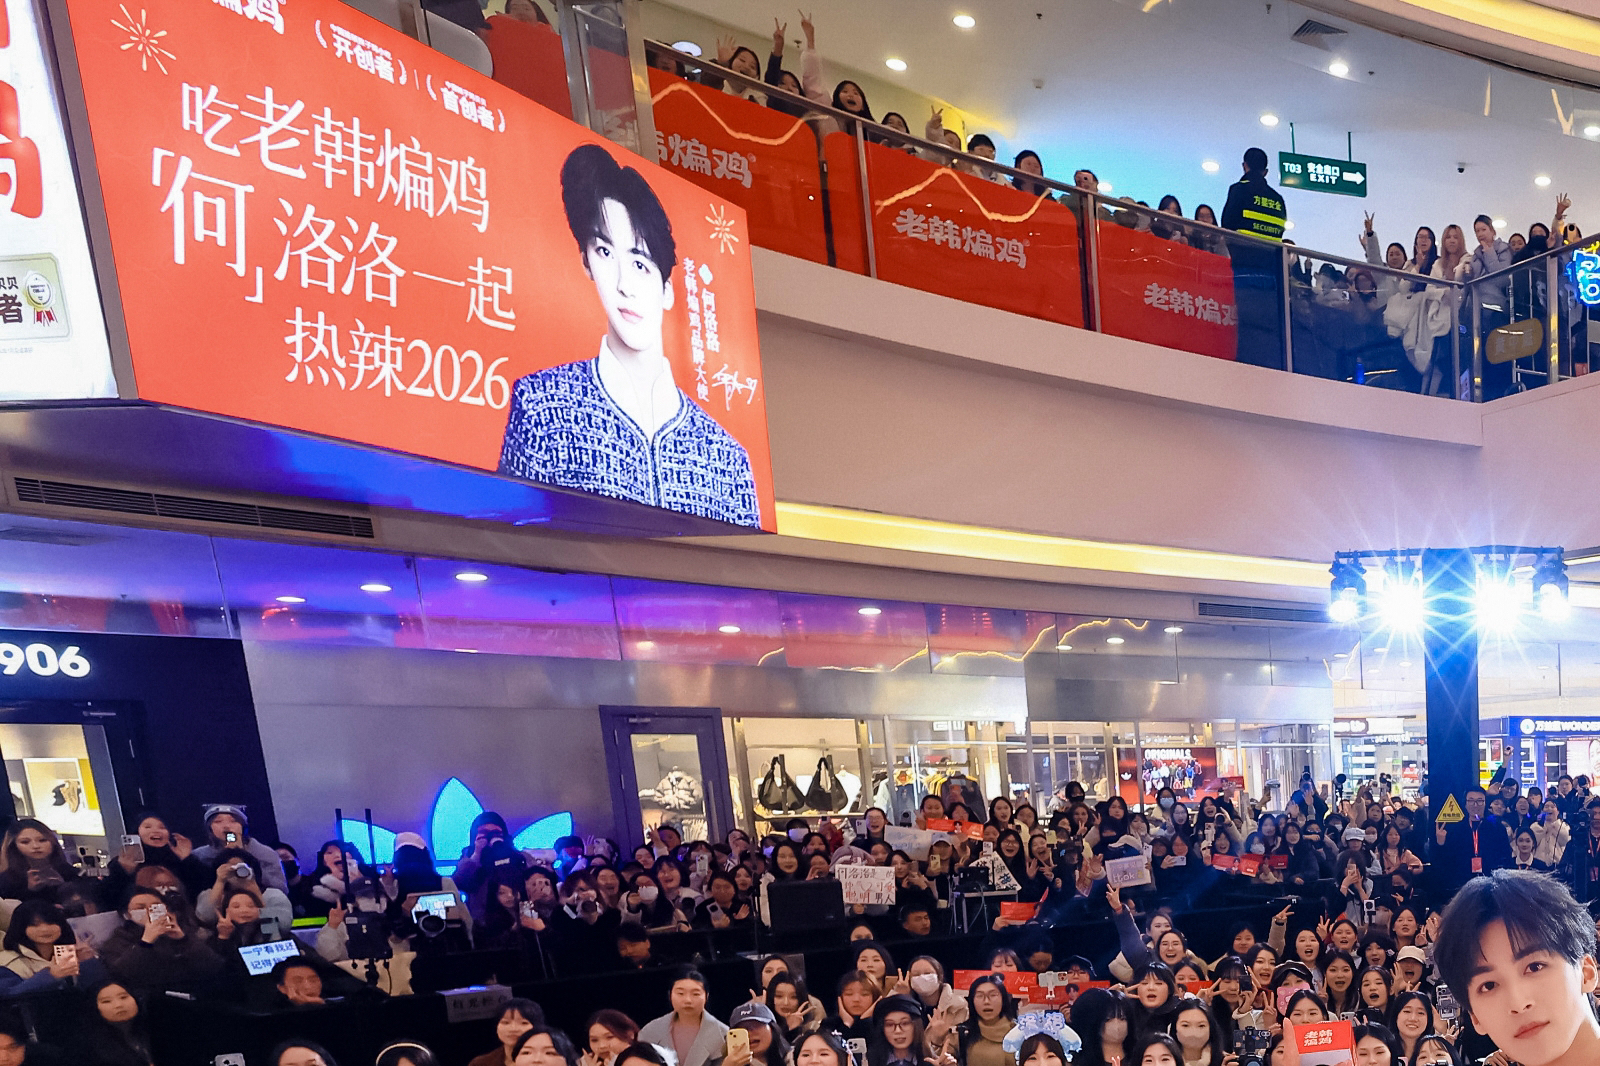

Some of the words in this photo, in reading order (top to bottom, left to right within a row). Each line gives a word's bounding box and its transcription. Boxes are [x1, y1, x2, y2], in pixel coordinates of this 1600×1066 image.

[331, 34, 394, 84] 开创者
[440, 86, 494, 131] 首创者
[181, 82, 488, 234] 吃老韩煸鸡
[1283, 162, 1302, 174] T03
[1307, 161, 1340, 176] 安全出口
[1309, 173, 1338, 184] EXIT
[1253, 222, 1282, 234] SECURITY
[895, 207, 1026, 269] 老韩煸鸡
[284, 306, 510, 411] 热辣2026
[1144, 748, 1192, 759] ORIGINALS
[1304, 1029, 1333, 1039] 老韩
